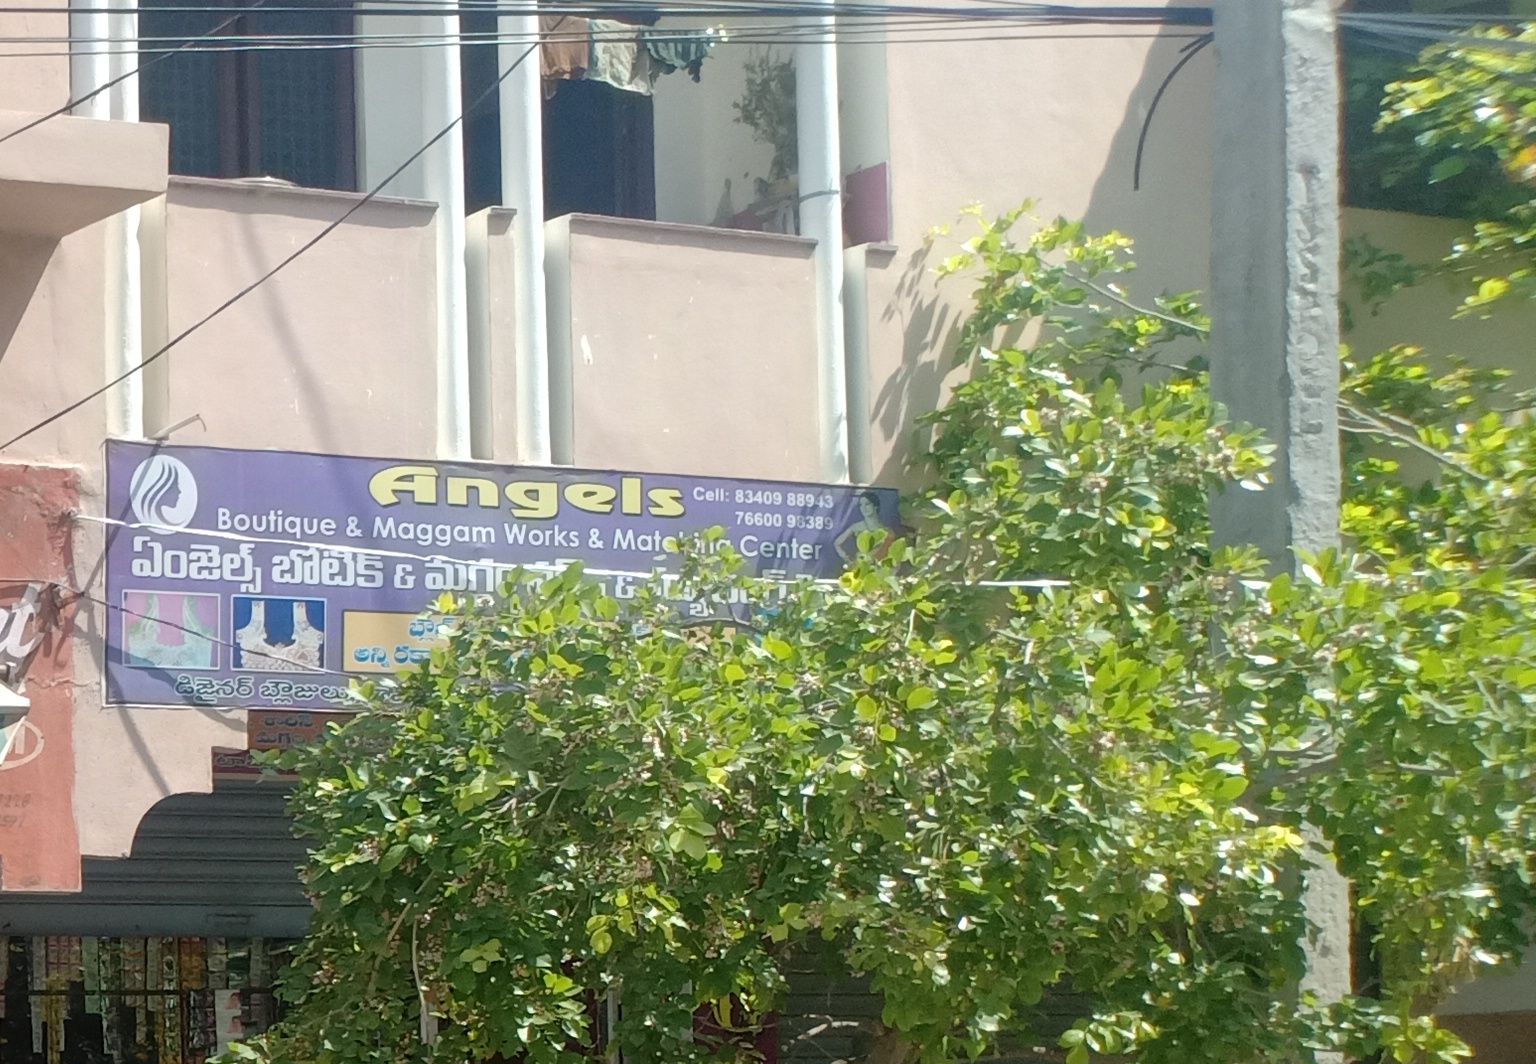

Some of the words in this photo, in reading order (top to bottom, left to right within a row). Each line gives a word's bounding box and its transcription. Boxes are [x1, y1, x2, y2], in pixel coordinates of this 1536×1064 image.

[367, 464, 686, 520] Angels
[693, 486, 729, 503] Cell:
[735, 488, 783, 506] 83409
[216, 506, 337, 538] Boutique
[345, 516, 363, 537] &
[372, 515, 496, 548] Maggam
[504, 522, 580, 550] Works
[588, 527, 604, 549] &
[740, 535, 823, 561] Center
[735, 511, 782, 528] 76600
[393, 562, 415, 590] &
